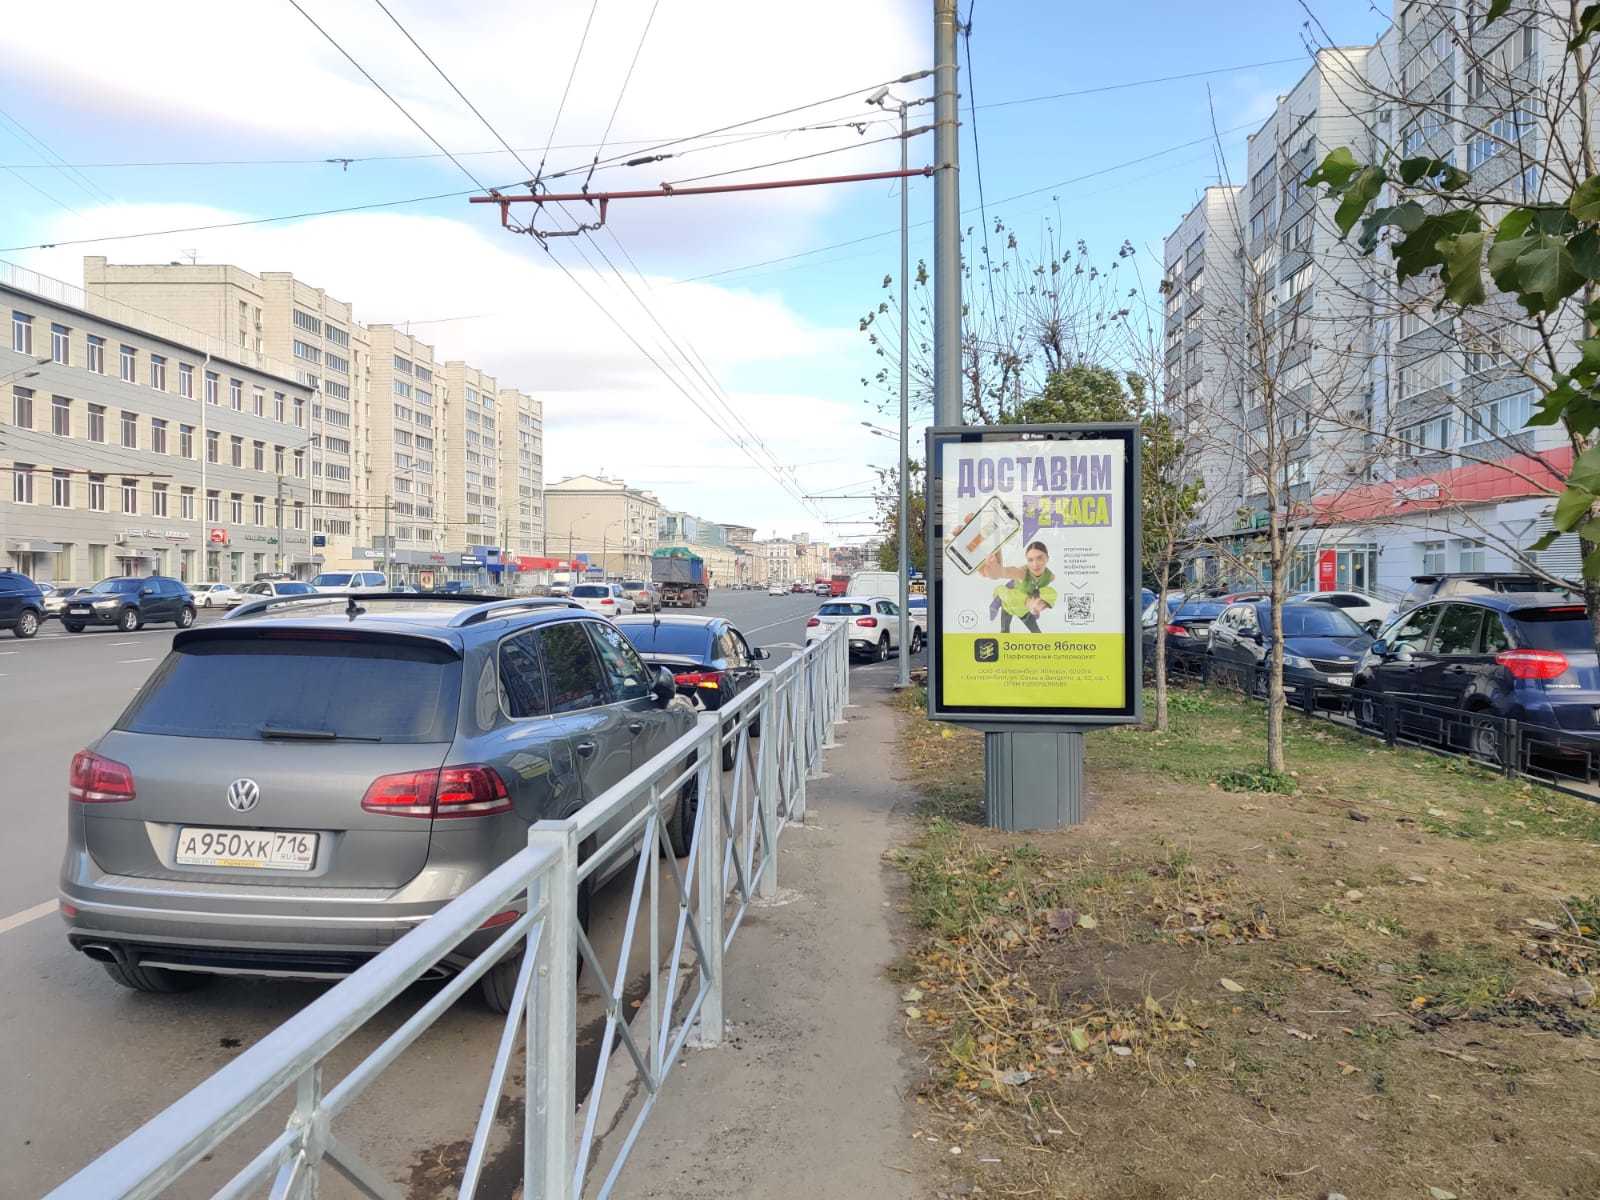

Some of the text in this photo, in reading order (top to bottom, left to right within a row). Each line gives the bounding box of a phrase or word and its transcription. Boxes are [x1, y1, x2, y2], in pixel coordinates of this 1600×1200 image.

[958, 455, 1111, 498] ДОСТАВИМ
[1055, 495, 1110, 526] ЧАСА
[961, 615, 975, 624] 12+
[1003, 641, 1097, 651] Золотое Яблоко
